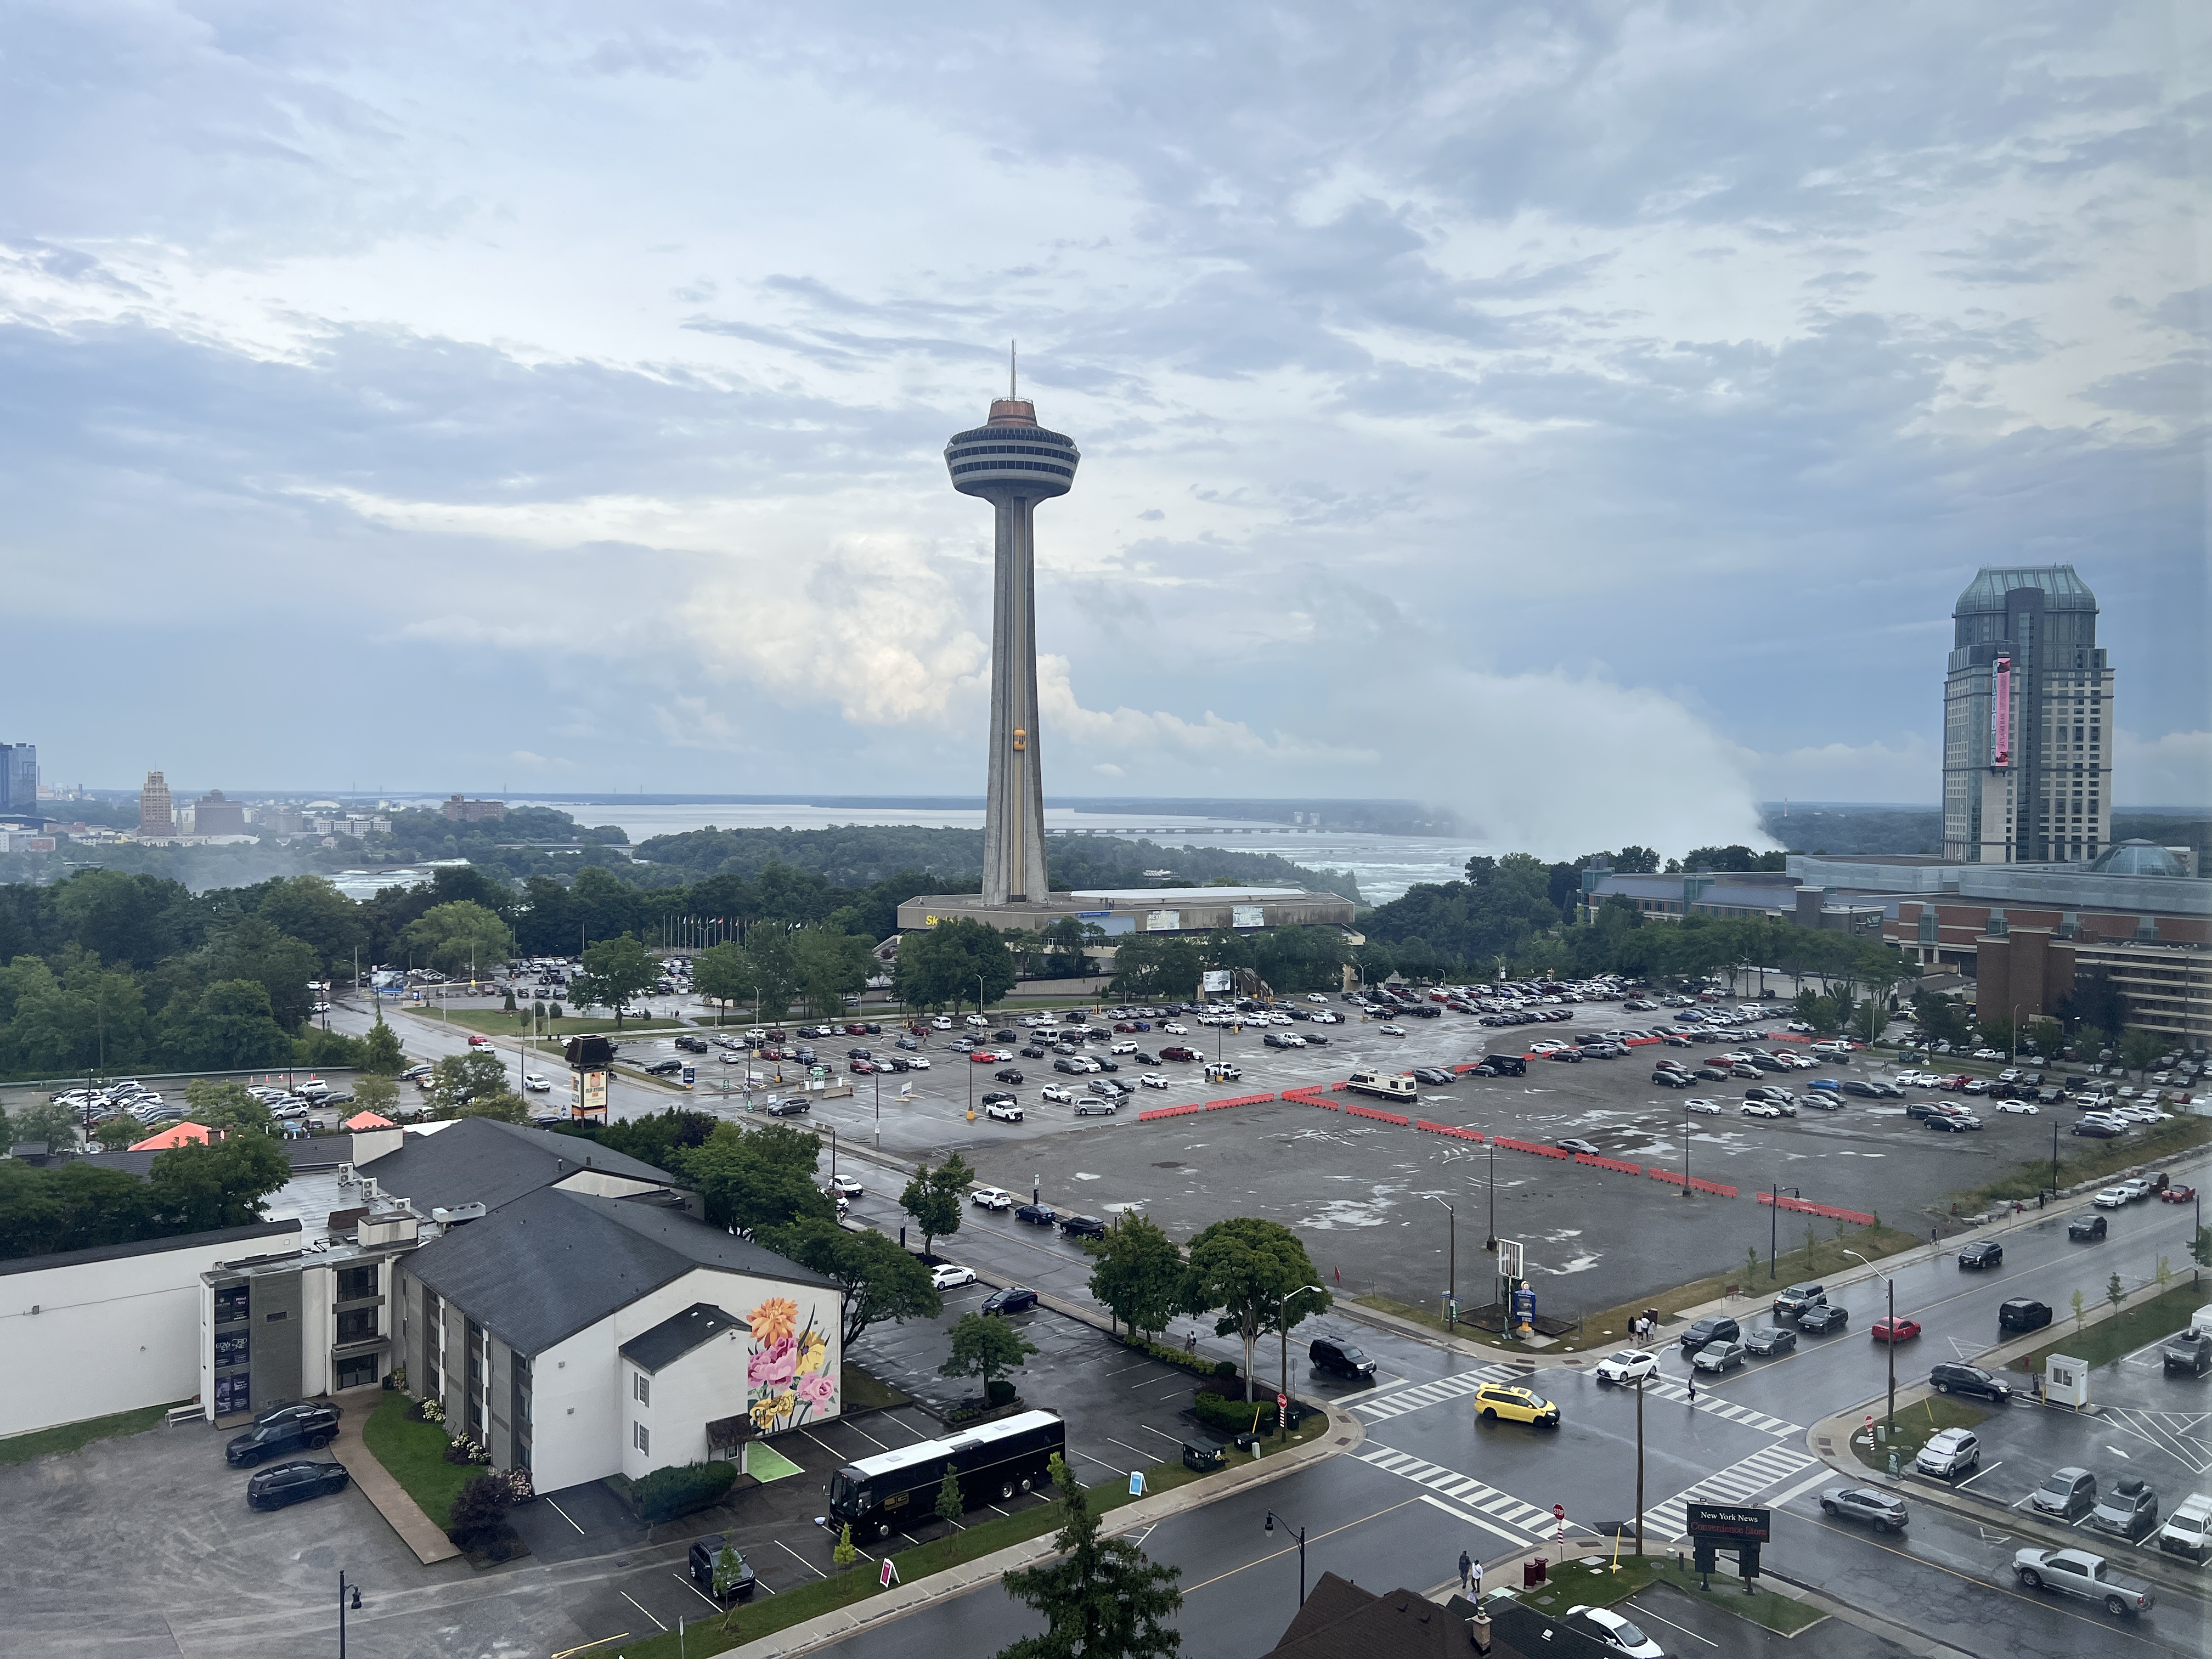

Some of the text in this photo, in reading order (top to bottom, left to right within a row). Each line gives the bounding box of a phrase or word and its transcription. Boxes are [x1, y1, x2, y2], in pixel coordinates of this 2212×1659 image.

[1554, 1508, 1564, 1516] STOP
[1719, 1513, 1736, 1521] York
[1737, 1514, 1758, 1523] News
[1691, 1521, 1767, 1536] Convenience Store
